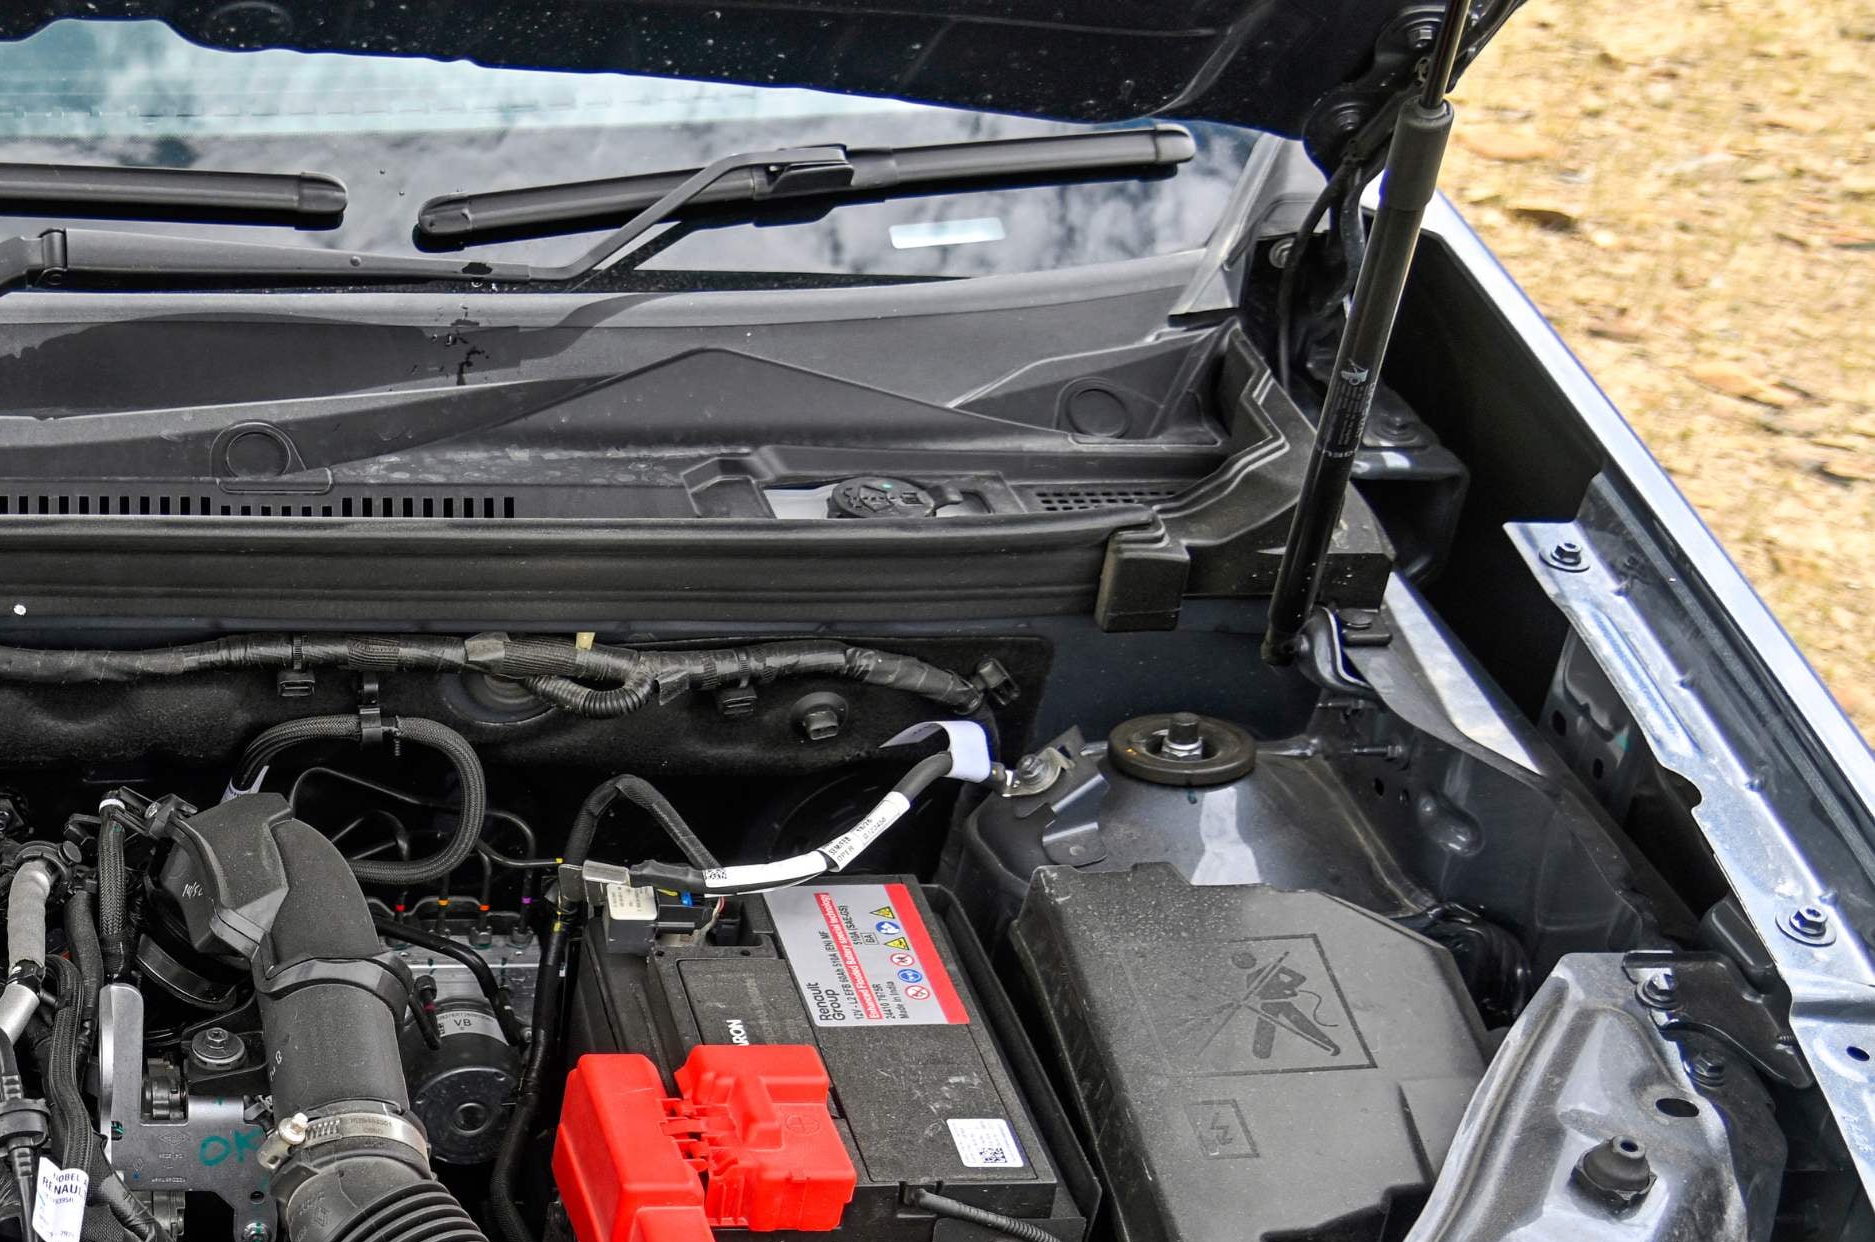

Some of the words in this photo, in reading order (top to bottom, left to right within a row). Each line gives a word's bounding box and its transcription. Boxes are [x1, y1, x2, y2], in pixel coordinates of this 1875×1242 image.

[821, 895, 838, 923] technology
[833, 924, 848, 944] special
[824, 941, 836, 952] (EN)
[842, 944, 856, 964] Battery
[850, 965, 866, 988] Flooded
[842, 984, 854, 996] EFB
[887, 981, 899, 995] India
[807, 982, 829, 1021] Renault
[826, 989, 846, 1021] Group
[859, 989, 879, 1018] Enhanced
[897, 1003, 909, 1019] Made
[453, 1018, 471, 1027] VB
[852, 1009, 864, 1019] 12V
[199, 1129, 259, 1167] OK
